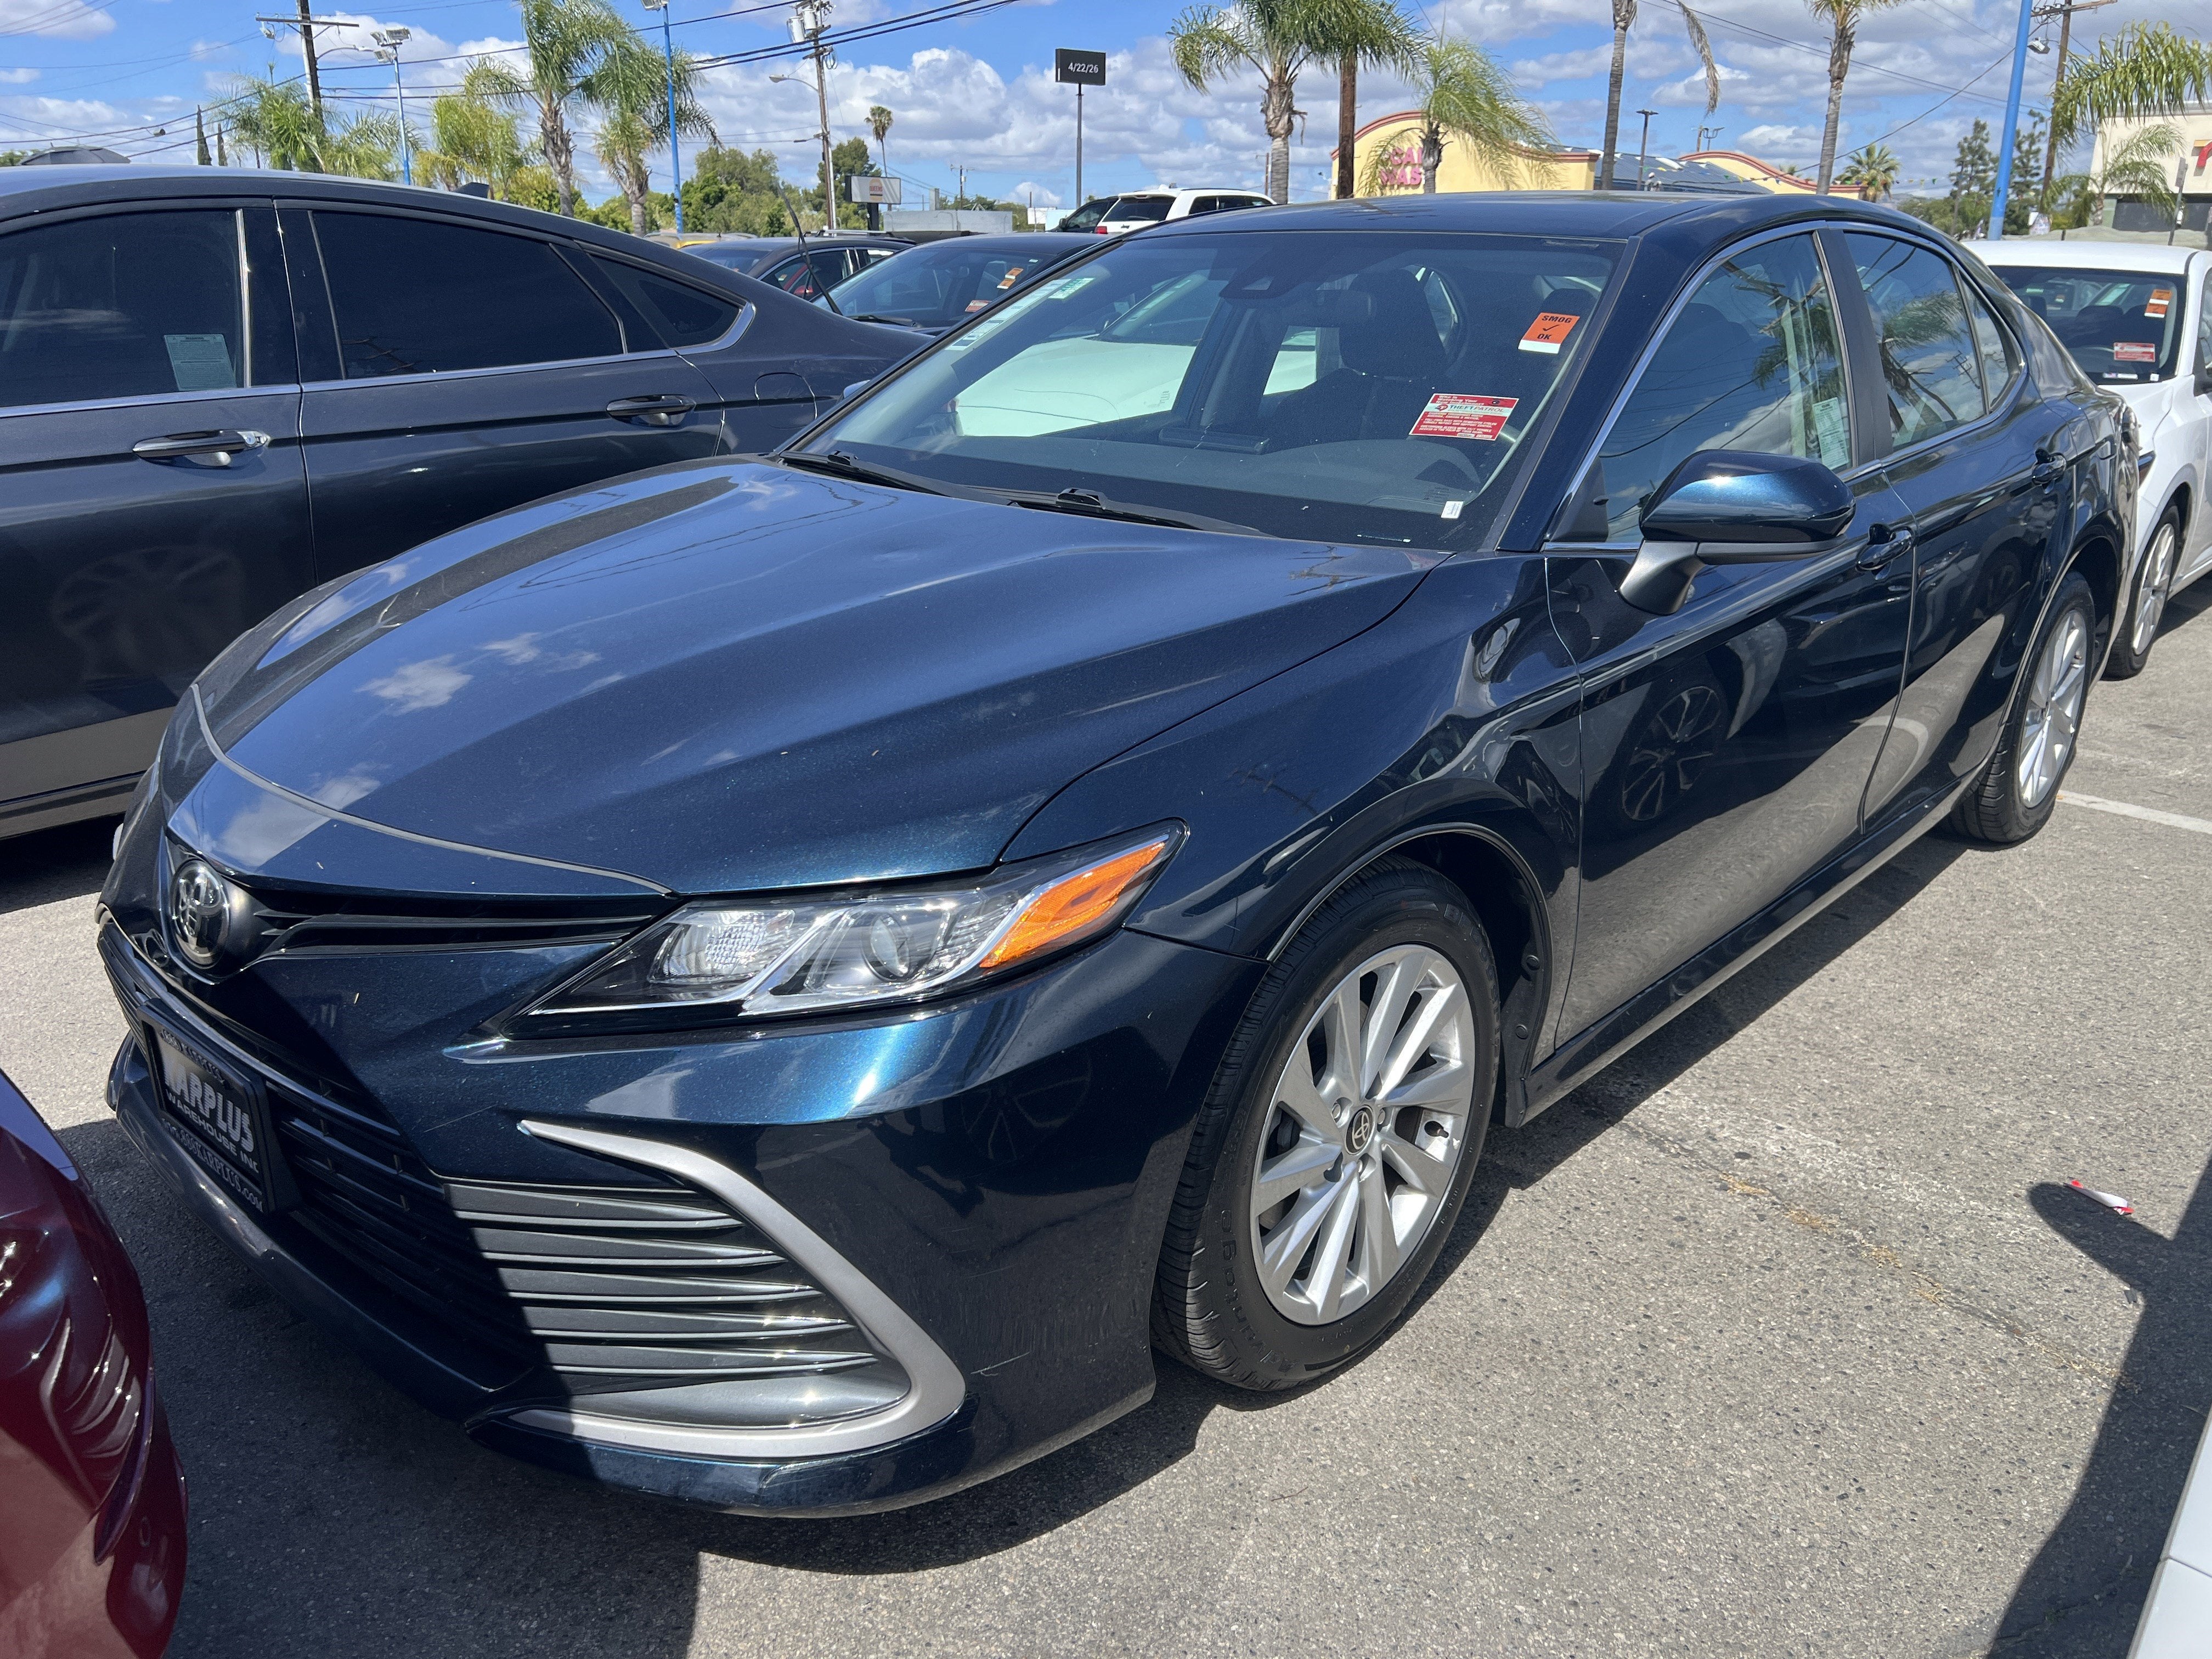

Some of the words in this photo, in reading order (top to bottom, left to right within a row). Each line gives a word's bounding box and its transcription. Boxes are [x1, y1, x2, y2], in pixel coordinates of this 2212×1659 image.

[1068, 62, 1099, 74] 4/22/26
[1390, 146, 1423, 165] CA
[1379, 166, 1423, 185] WAS
[1542, 315, 1572, 323] SMOG
[166, 1088, 237, 1156] WAREHOUSE
